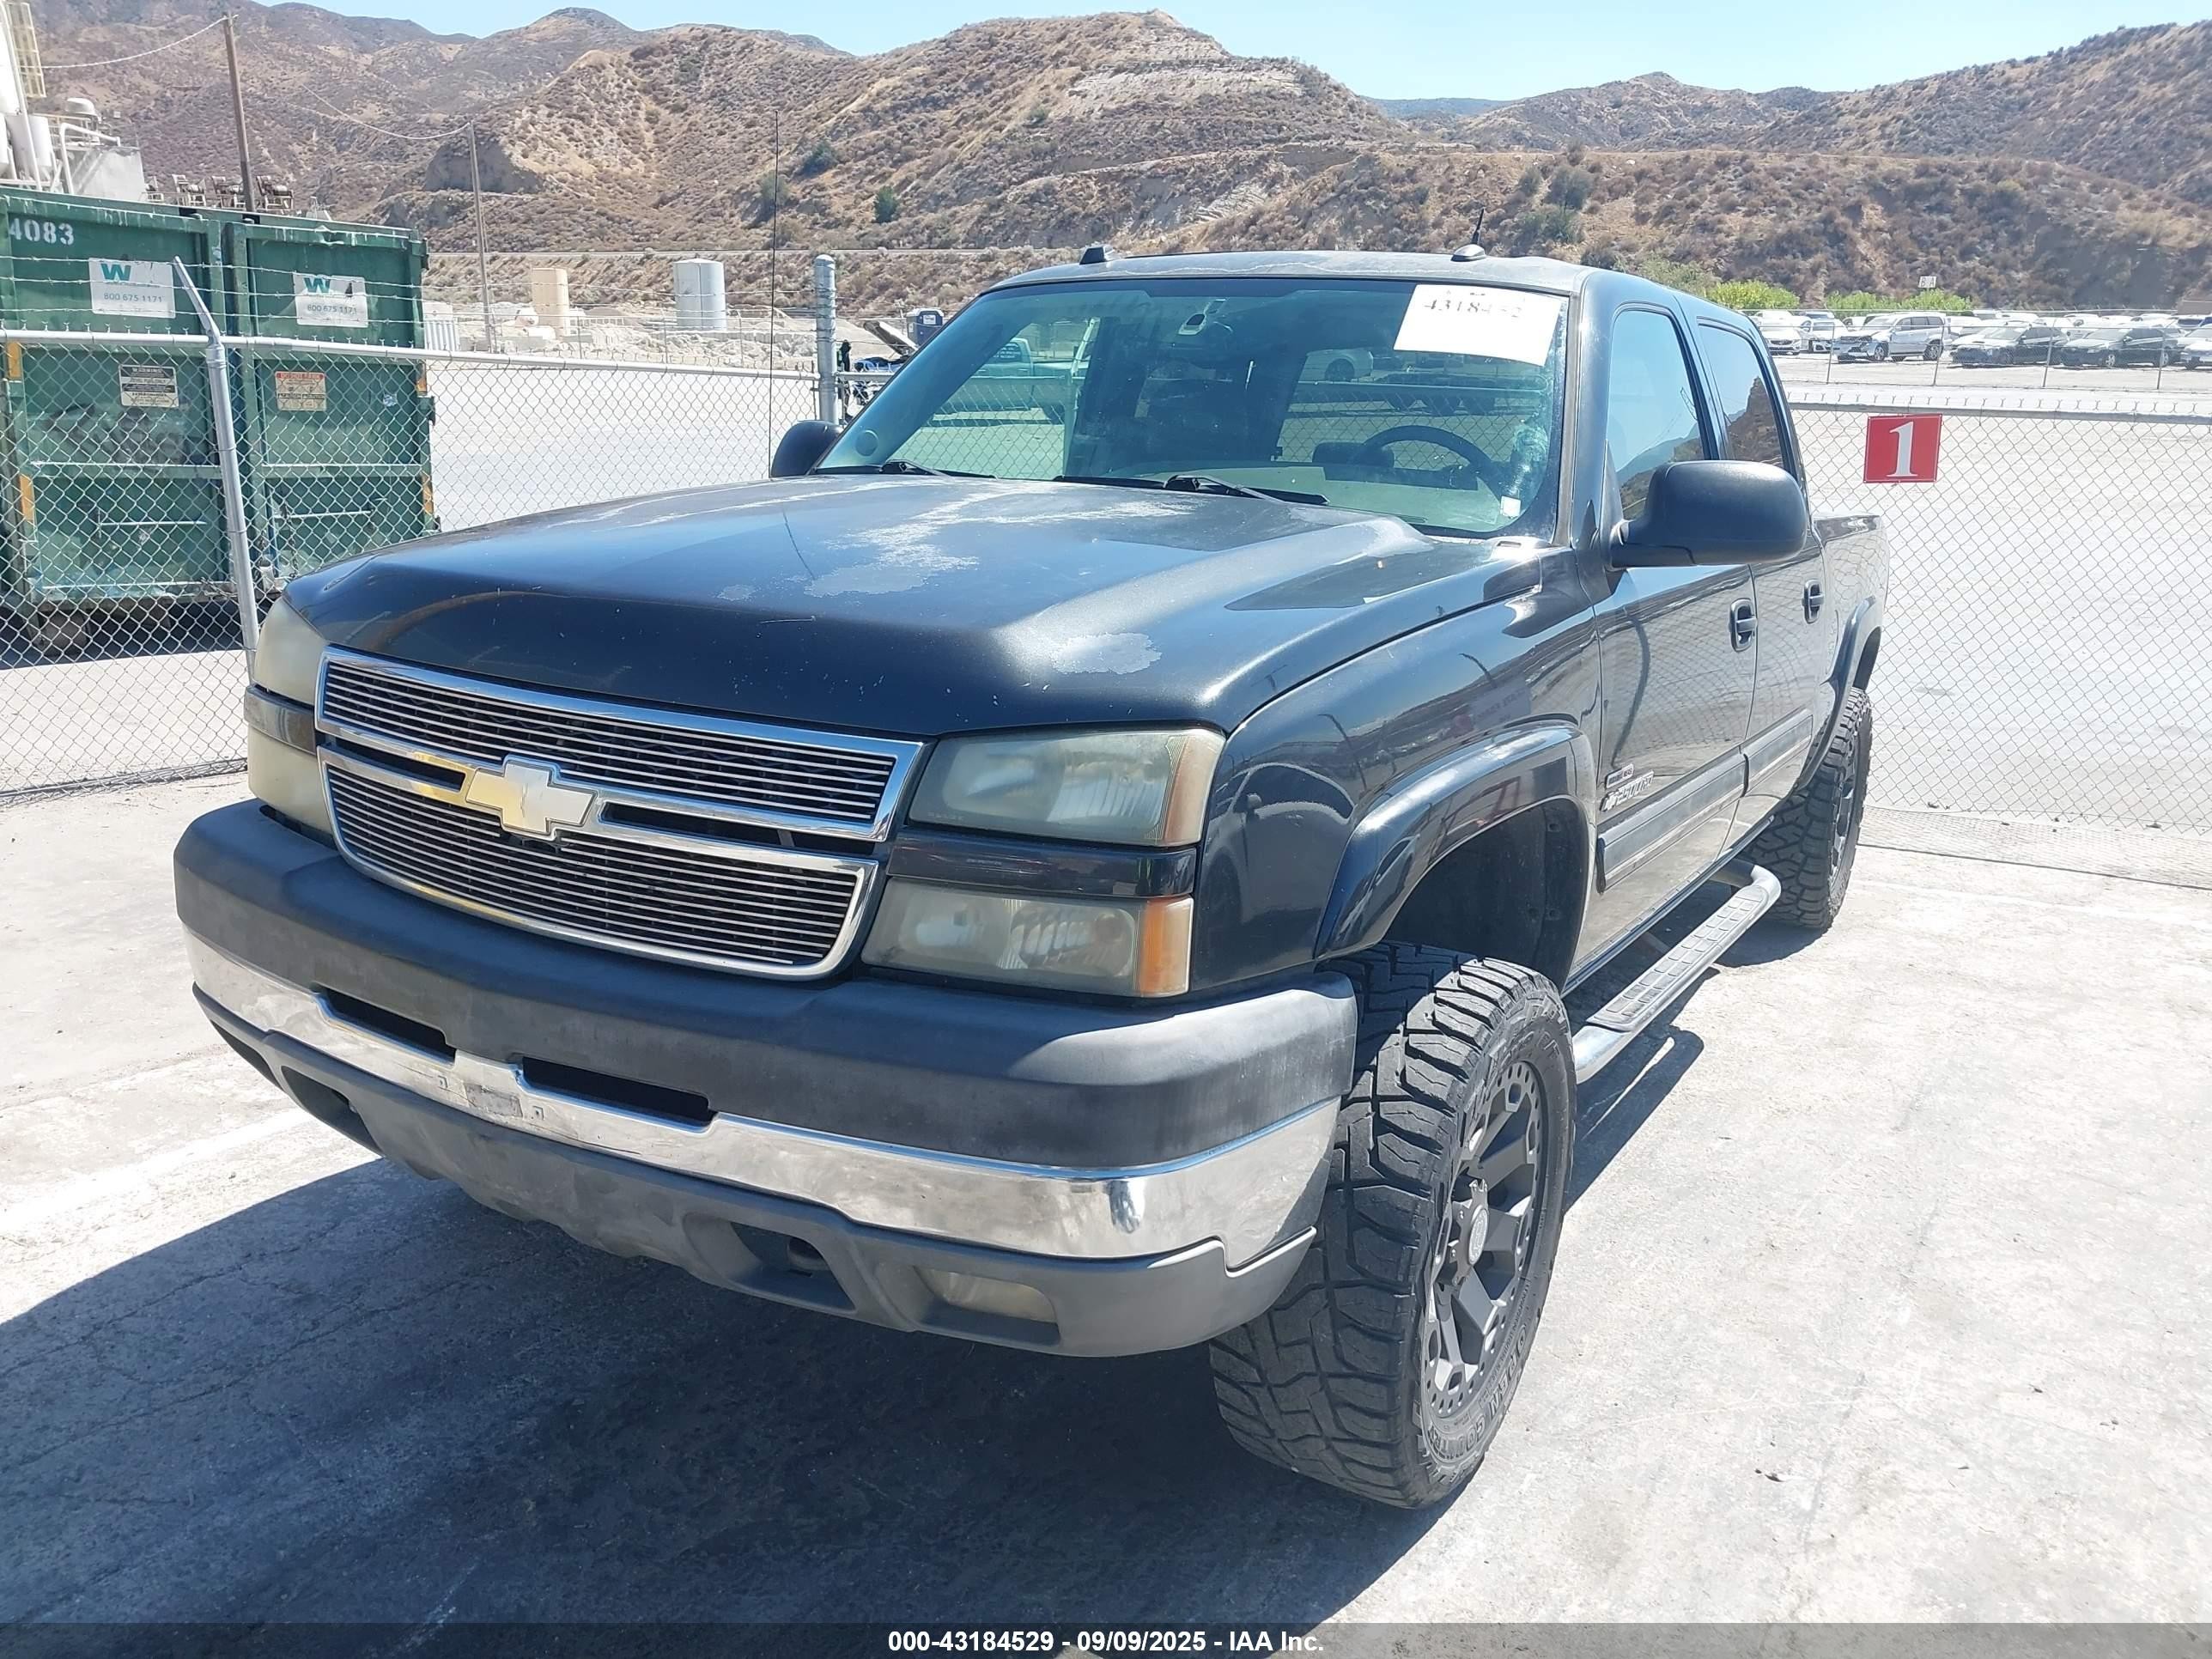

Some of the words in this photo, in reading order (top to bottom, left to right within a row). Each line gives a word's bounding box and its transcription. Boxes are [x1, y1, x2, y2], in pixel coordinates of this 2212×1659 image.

[9, 218, 74, 246] 4083
[100, 263, 131, 282] W
[104, 293, 120, 301] 800
[122, 294, 138, 302] 675
[143, 295, 162, 303] 1171
[1886, 421, 1918, 477] 1
